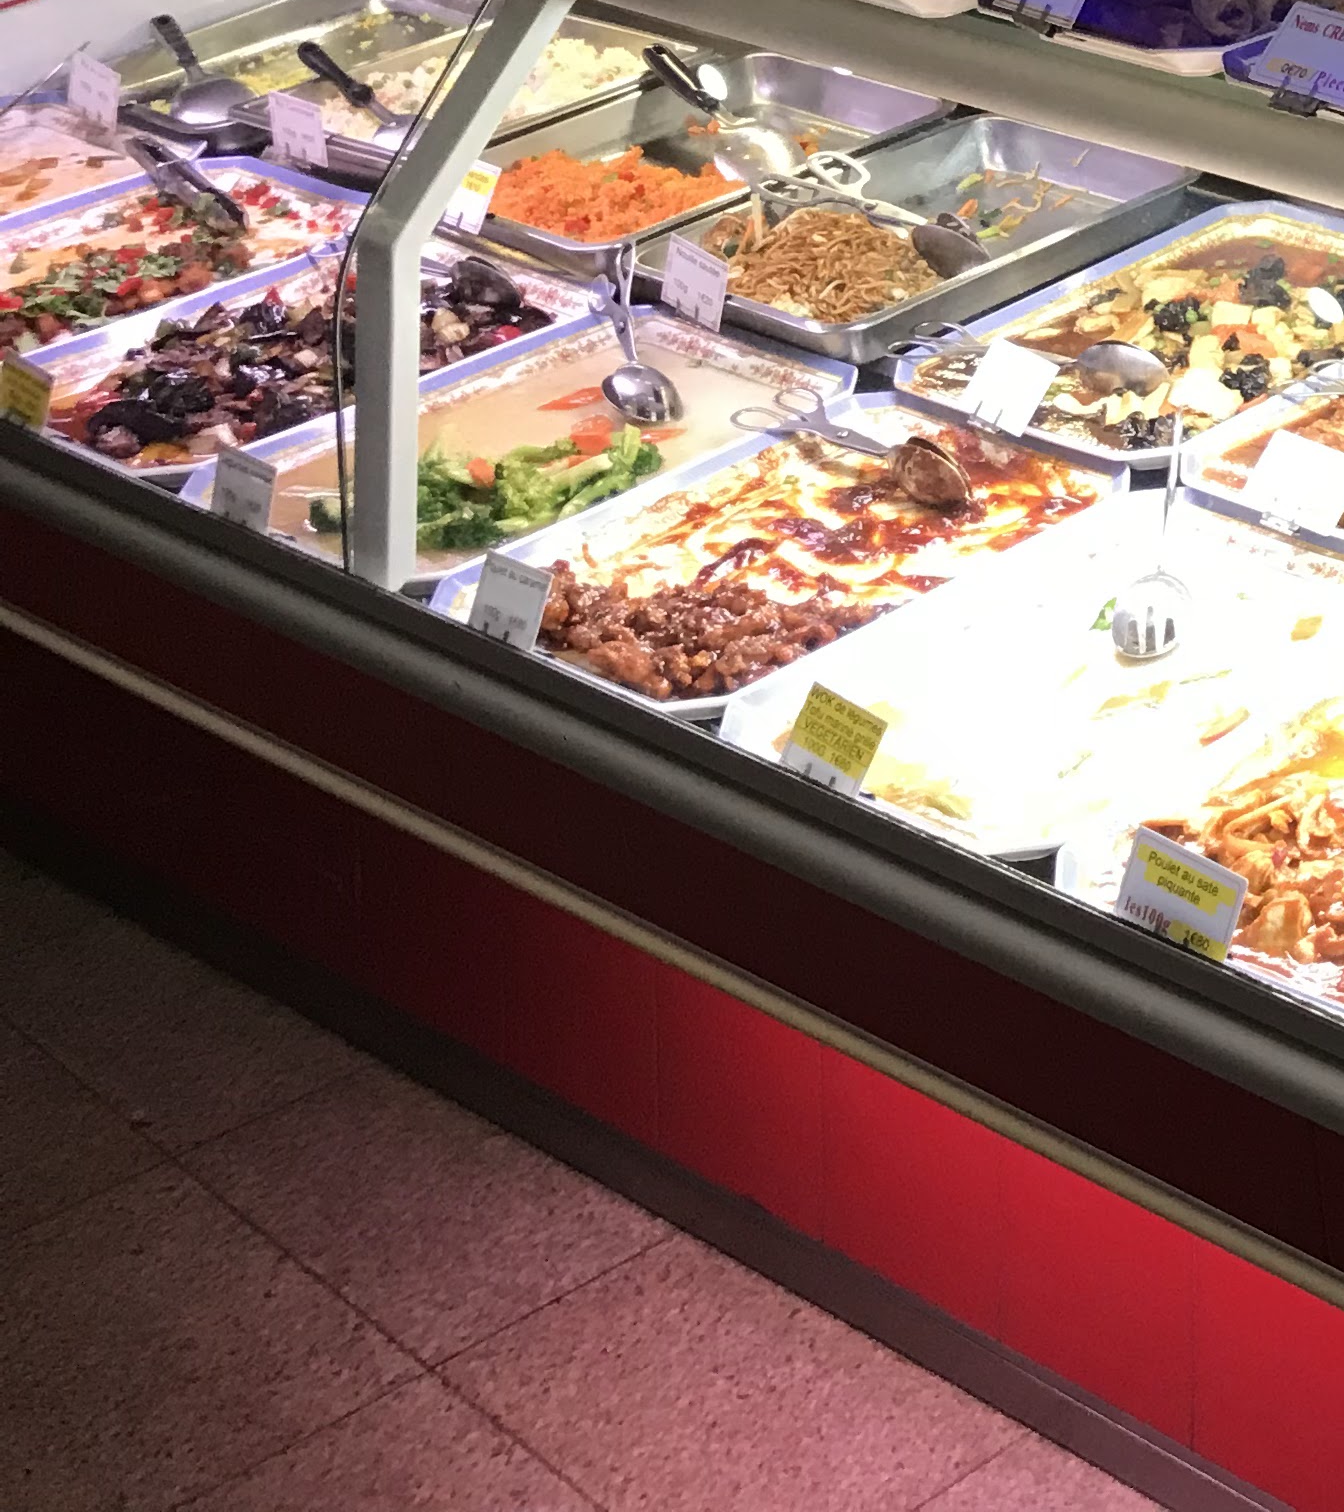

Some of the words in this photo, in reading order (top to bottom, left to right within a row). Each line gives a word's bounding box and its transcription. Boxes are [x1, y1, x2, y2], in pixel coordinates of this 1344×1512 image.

[1293, 15, 1319, 34] Nems
[1280, 62, 1308, 79] 0€70
[1147, 850, 1181, 876] Poulet
[1181, 871, 1196, 885] au
